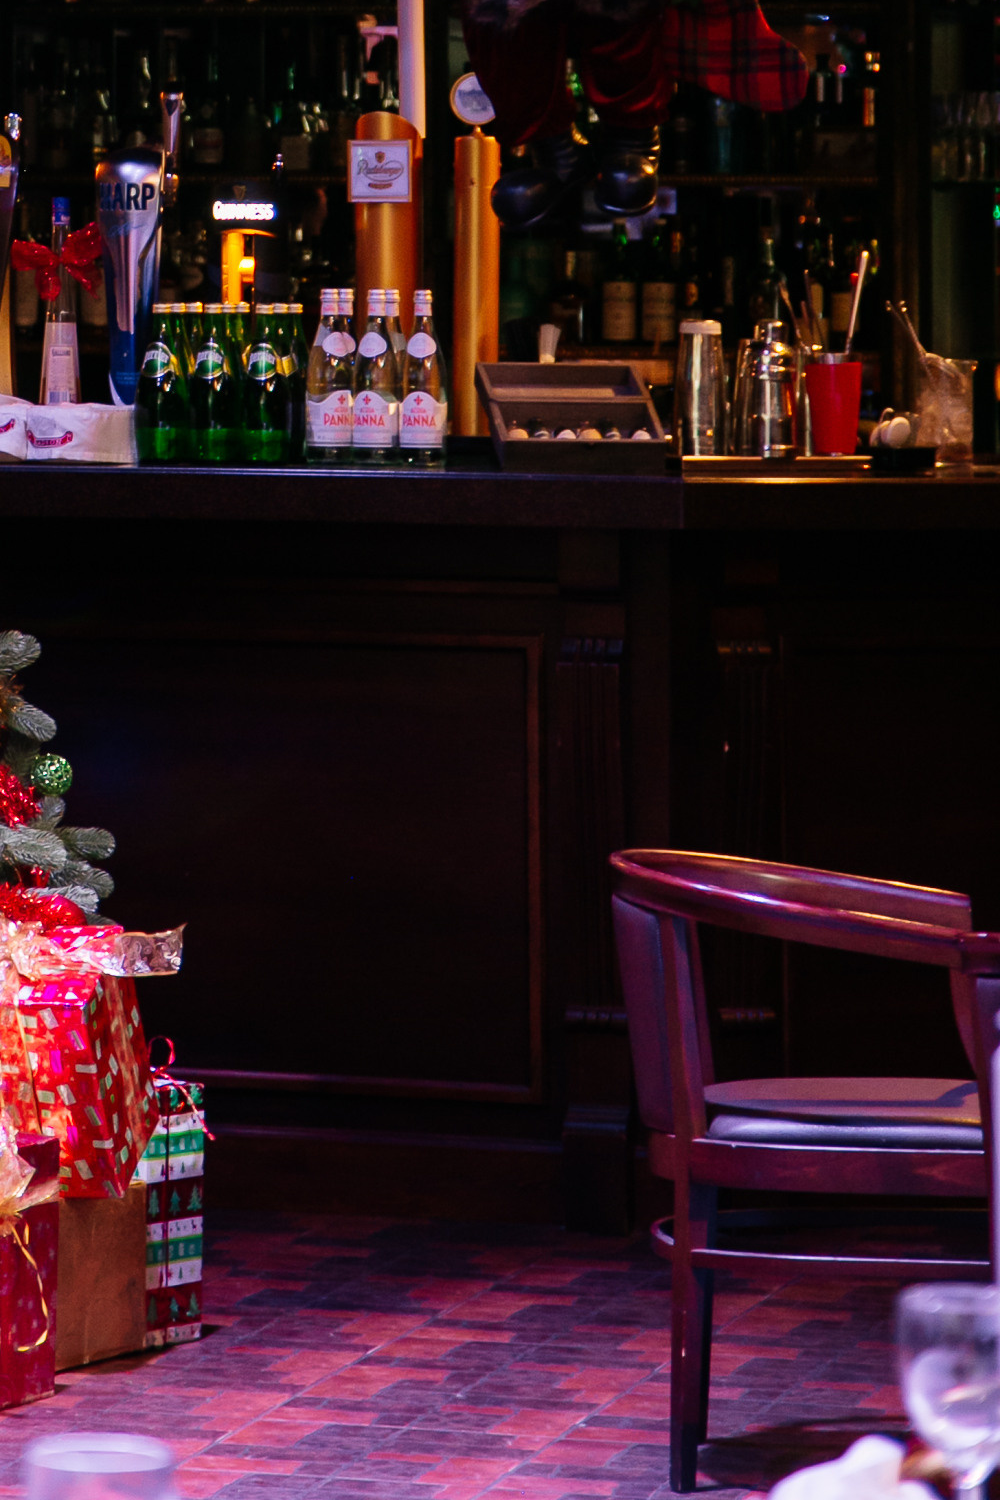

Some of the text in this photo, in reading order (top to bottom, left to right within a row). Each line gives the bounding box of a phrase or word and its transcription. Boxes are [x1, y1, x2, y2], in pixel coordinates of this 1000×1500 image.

[100, 182, 155, 210] HARP
[213, 201, 275, 220] GUINNESS
[403, 414, 436, 427] PANNA
